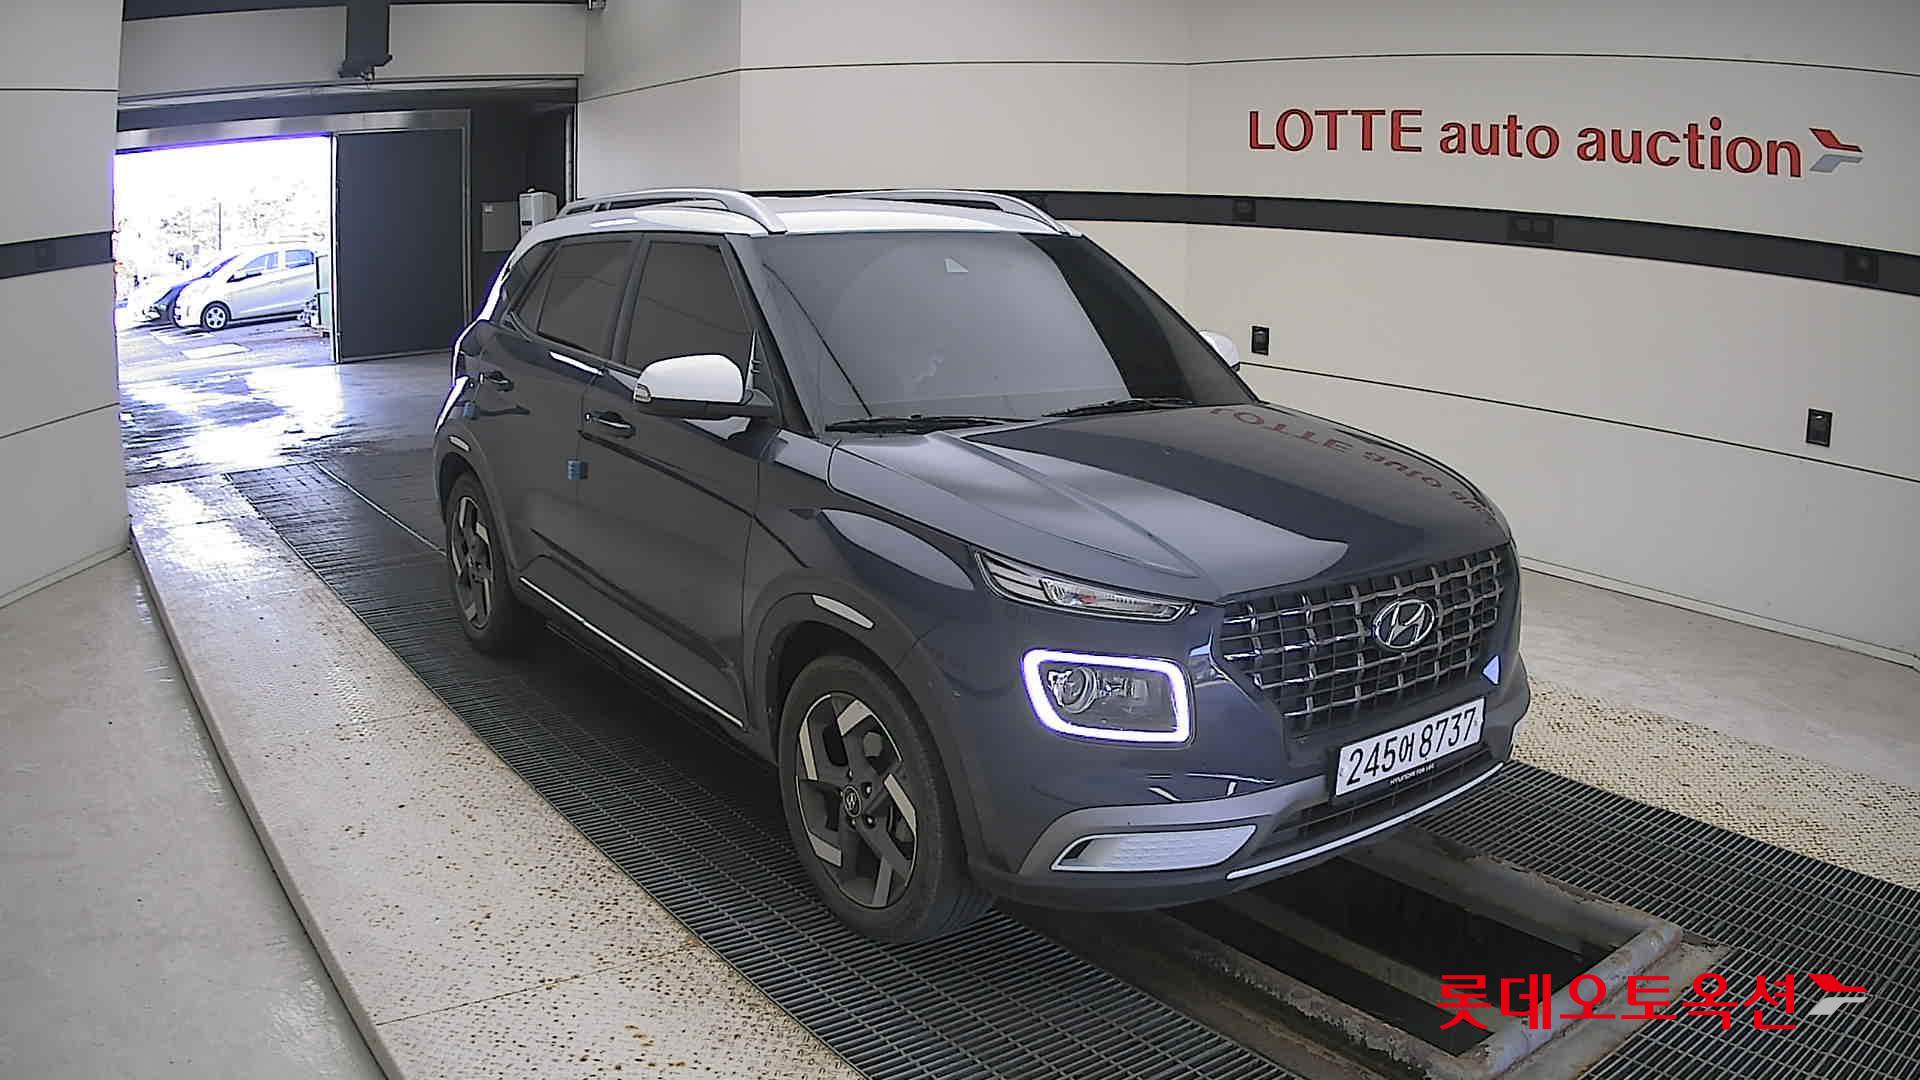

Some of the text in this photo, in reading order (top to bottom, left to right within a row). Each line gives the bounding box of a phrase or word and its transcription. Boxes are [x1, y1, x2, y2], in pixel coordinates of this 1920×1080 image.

[1248, 108, 1802, 178] LOTTE auto auction
